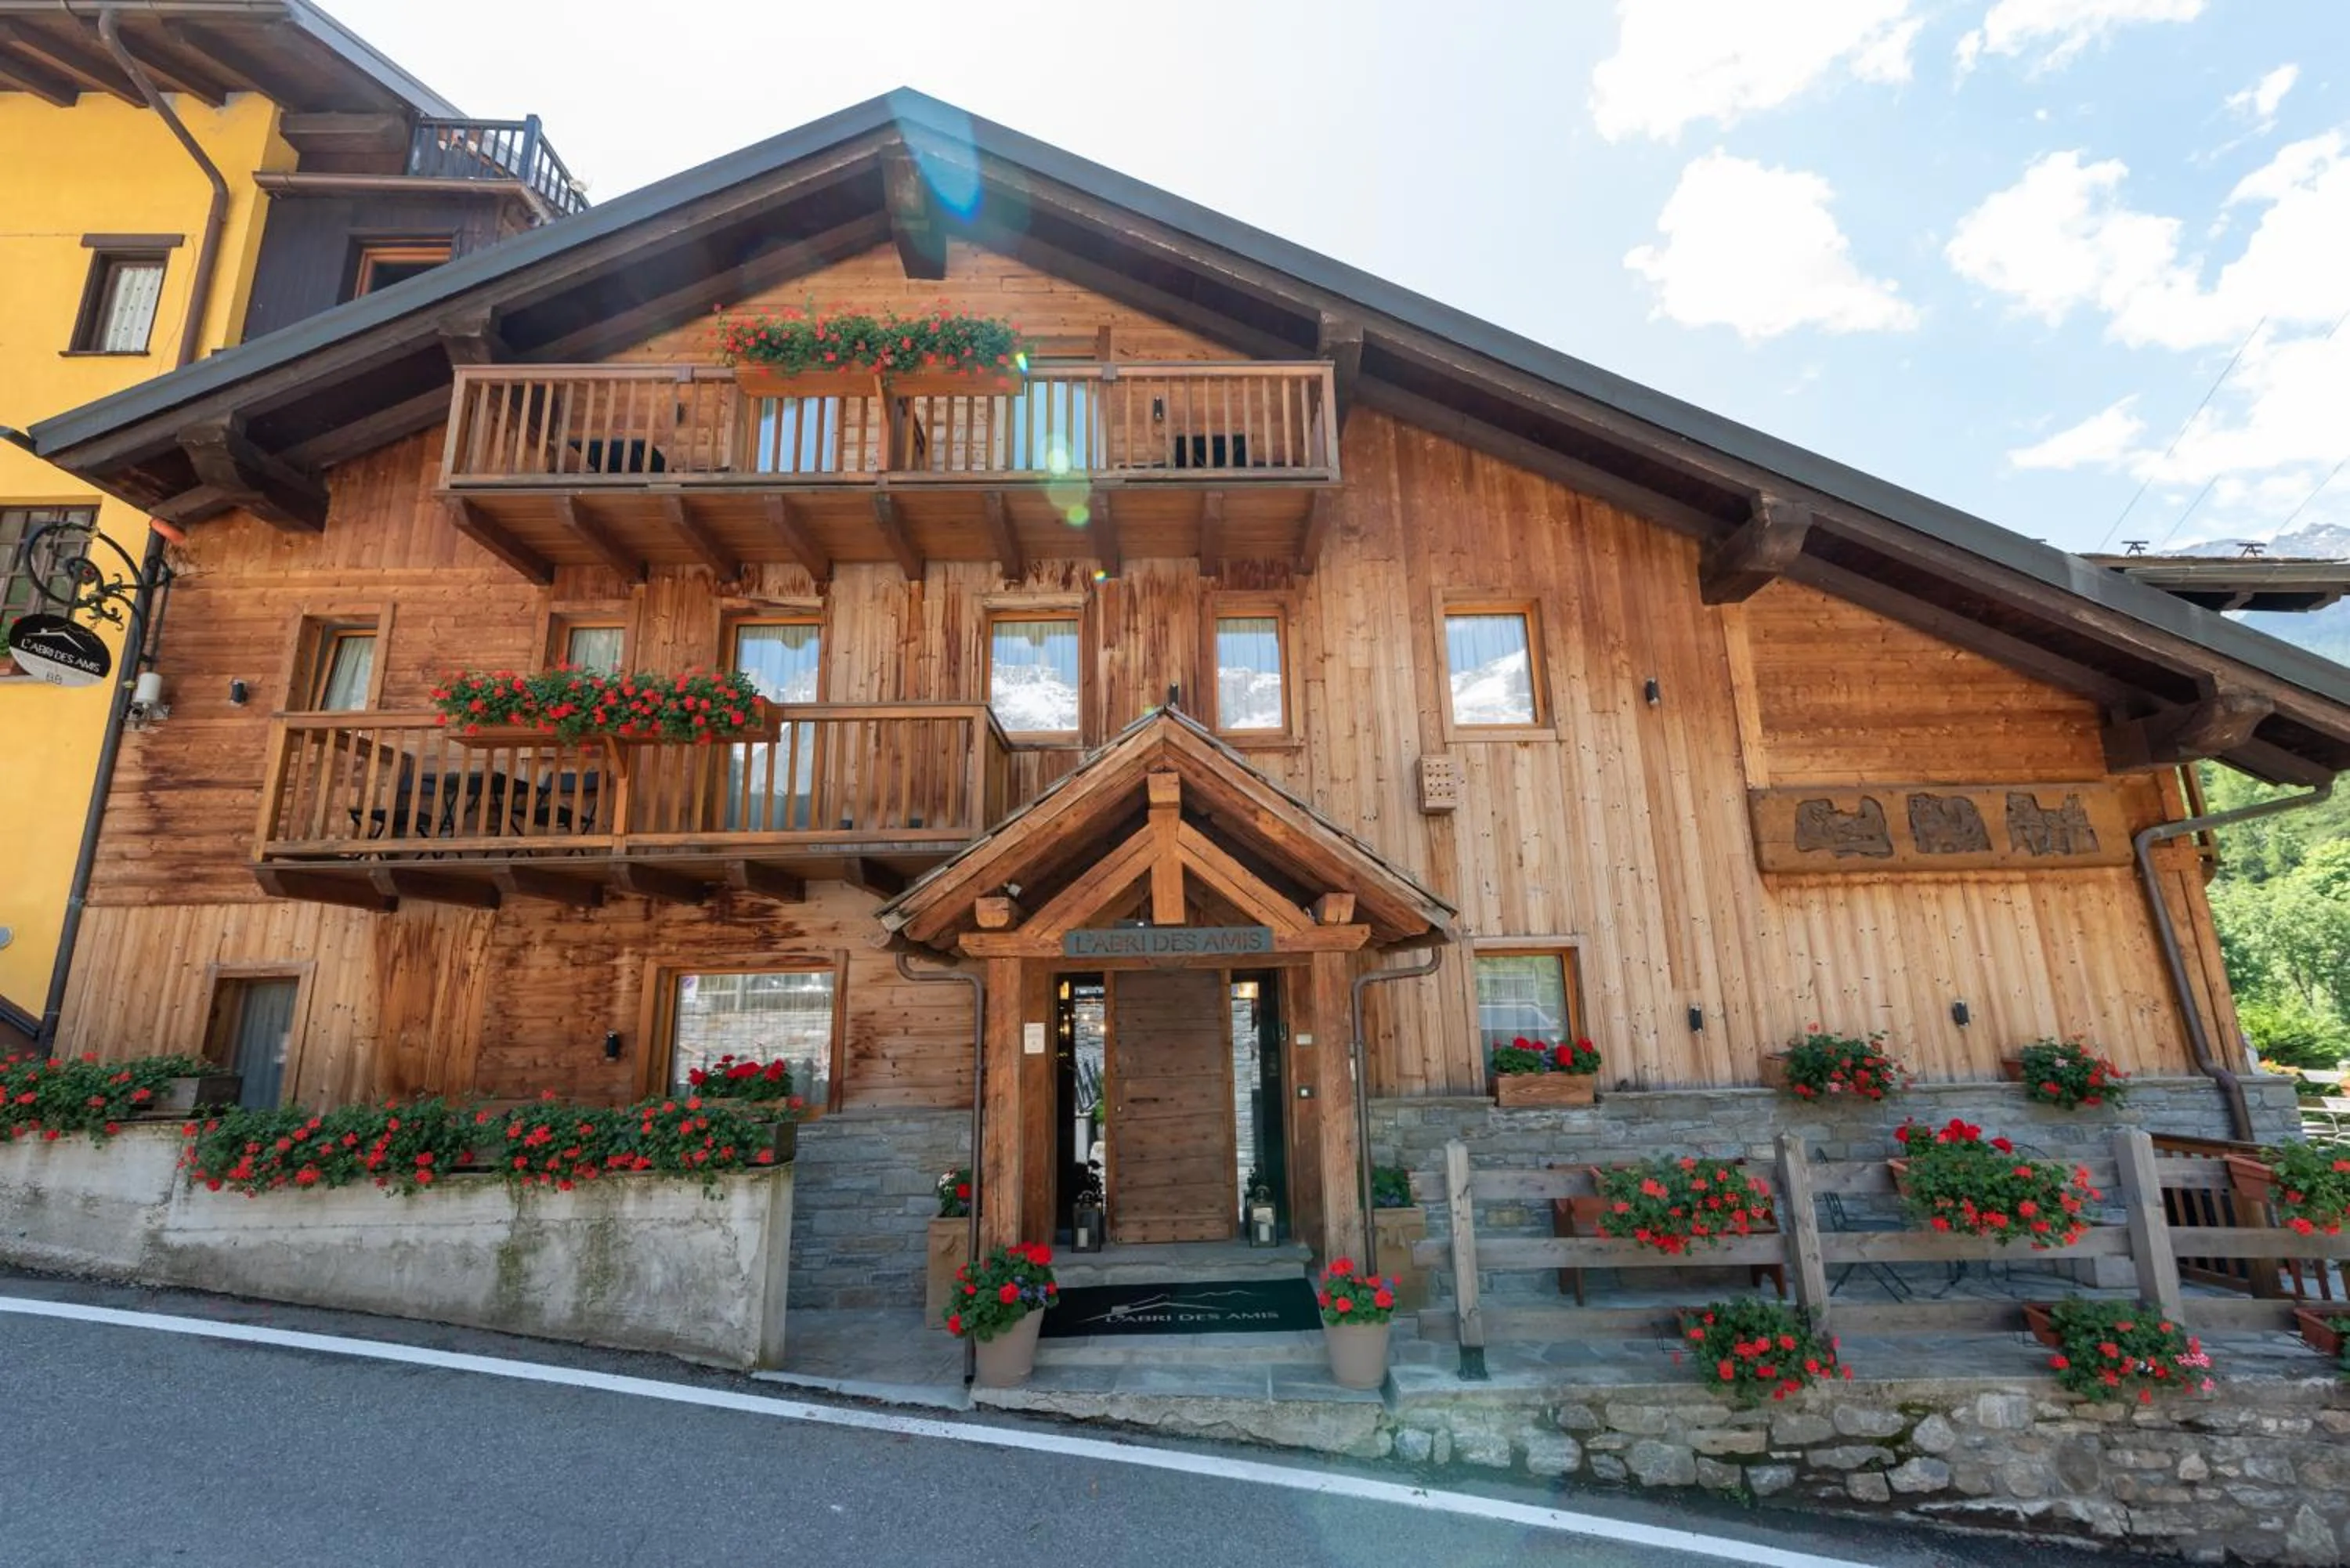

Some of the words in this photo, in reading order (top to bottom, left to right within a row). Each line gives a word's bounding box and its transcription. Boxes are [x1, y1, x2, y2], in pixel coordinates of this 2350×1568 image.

[20, 638, 53, 657] L'ABRI
[54, 651, 74, 664] DES
[75, 658, 100, 673] AMIS
[1076, 932, 1144, 953] L'ABRI
[1153, 932, 1198, 952] DES
[1203, 930, 1261, 951] AMIS
[1105, 1314, 1171, 1323] L'ABRI
[1178, 1313, 1220, 1322] DES
[1225, 1311, 1279, 1321] AMIS
